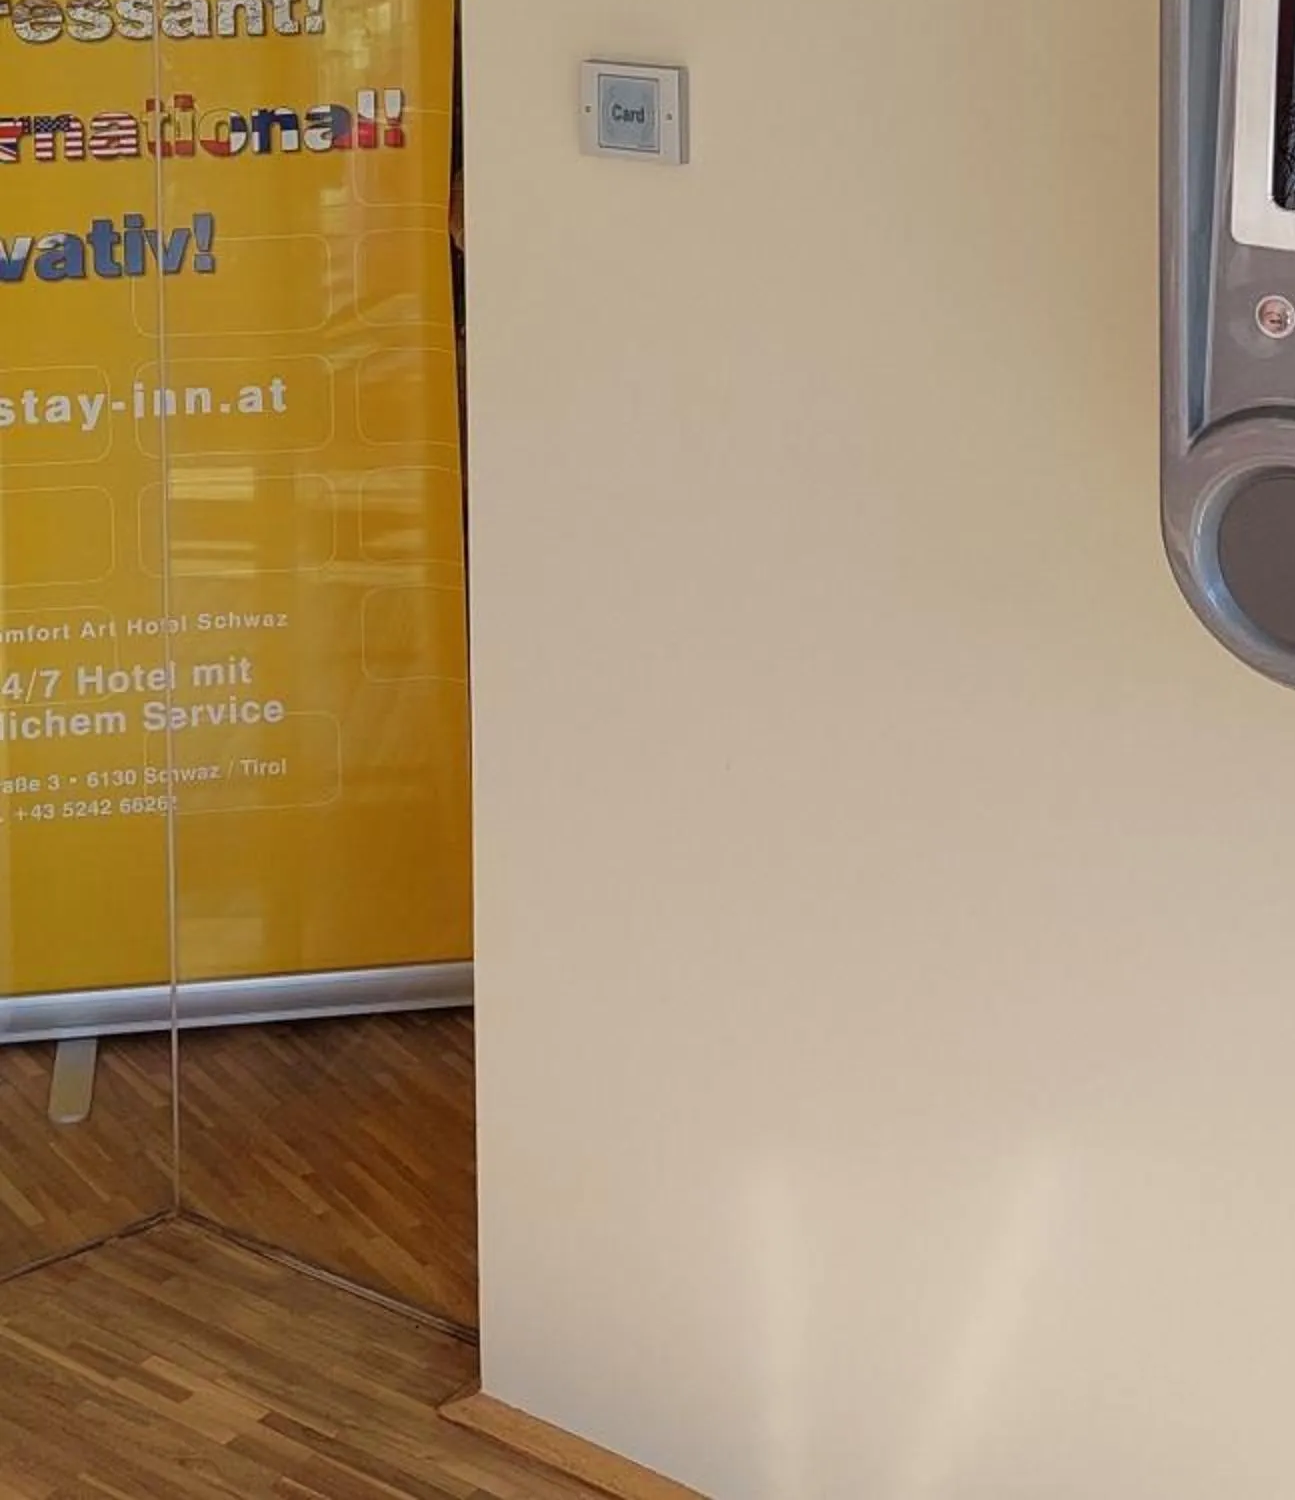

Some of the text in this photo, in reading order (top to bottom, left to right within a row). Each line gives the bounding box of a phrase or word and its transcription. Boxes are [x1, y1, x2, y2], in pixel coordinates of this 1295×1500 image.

[611, 103, 645, 124] Card
[0, 611, 288, 643] mfort Art Hotel Schwaz
[77, 660, 176, 695] Hotel
[192, 656, 252, 687] mit
[143, 696, 284, 731] Service
[48, 774, 60, 791] 3
[86, 768, 136, 788] 6130
[144, 763, 221, 784] Schwaz
[240, 758, 287, 776] Tirol
[16, 803, 54, 820] +43
[62, 800, 111, 817] 5242
